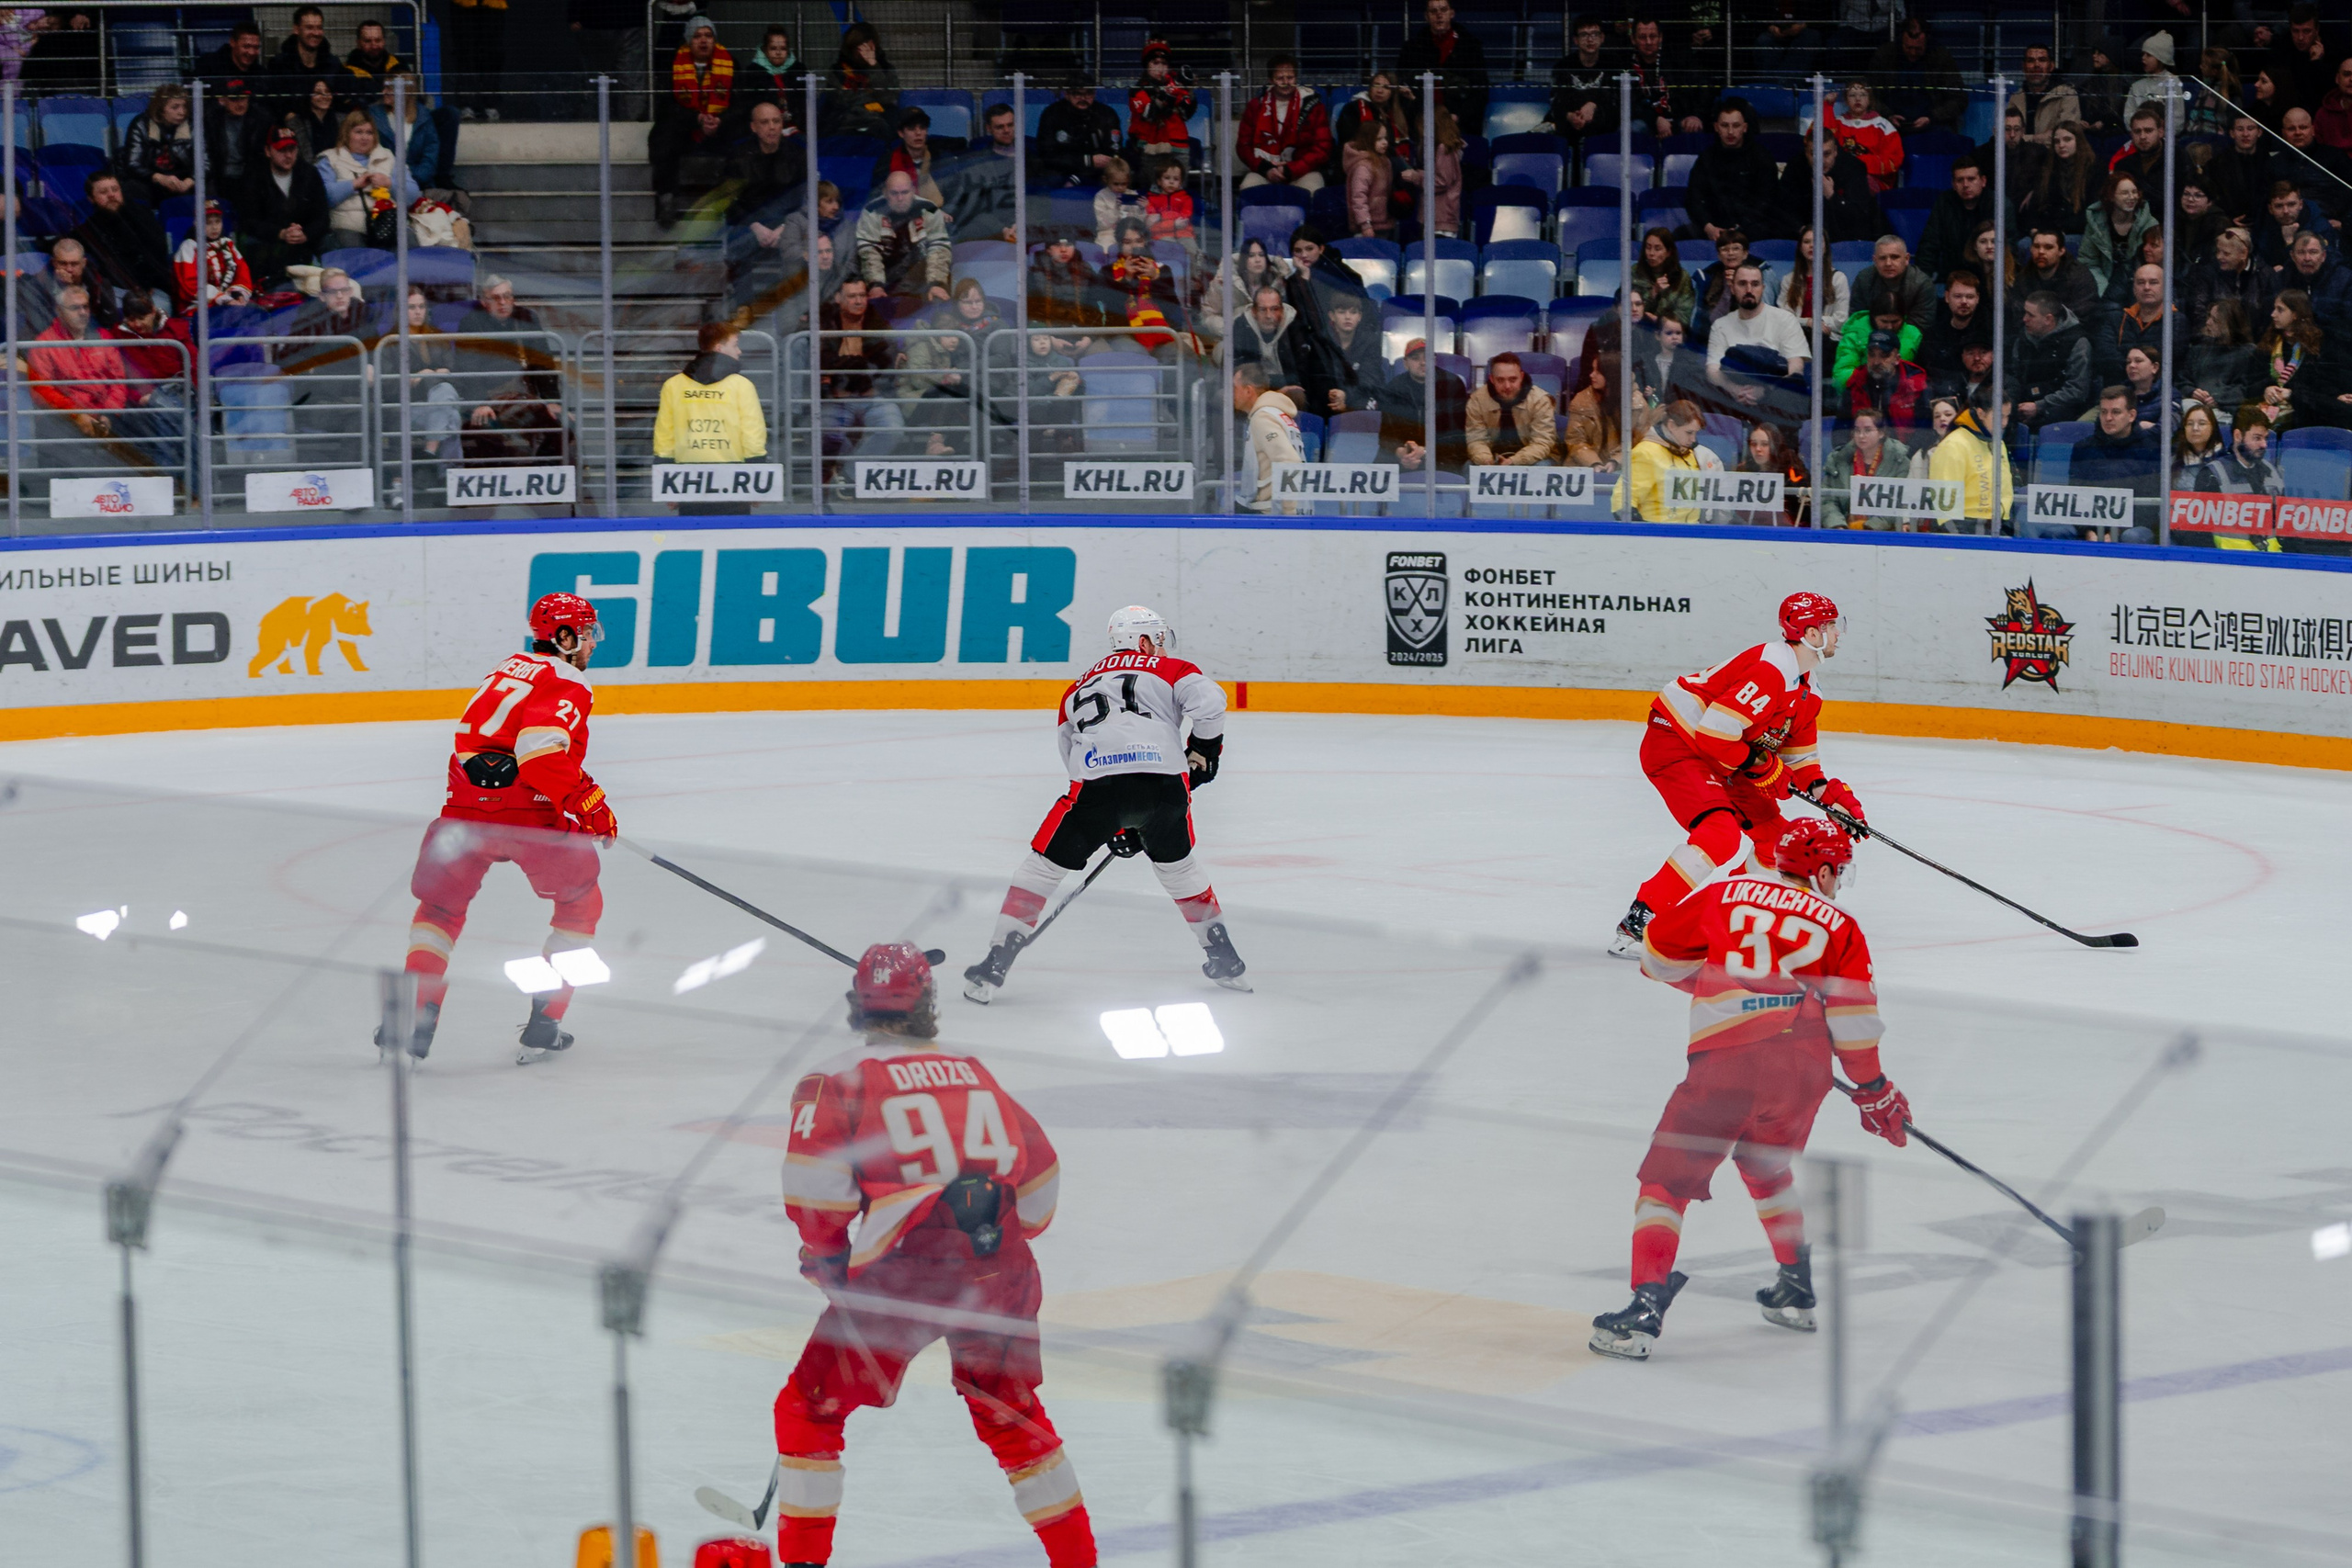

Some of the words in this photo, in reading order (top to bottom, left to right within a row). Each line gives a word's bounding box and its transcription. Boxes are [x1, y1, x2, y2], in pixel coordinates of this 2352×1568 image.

[684, 389, 726, 400] SAFETY
[690, 438, 731, 450] AFETY
[454, 472, 569, 500] KHL.RU
[662, 470, 775, 494] KHL.RU
[864, 468, 978, 491] KHL.RU
[1073, 468, 1185, 492] KHL.RU
[1280, 469, 1392, 495] KHL.RU
[1477, 471, 1587, 498] KHL.RU
[1671, 476, 1777, 504] KHL.RU
[93, 494, 120, 504] АВТО
[289, 487, 318, 498] АВТО
[297, 495, 333, 507] РАДИО
[1857, 482, 1958, 512] KHL.RU
[99, 502, 134, 513] РАДИО
[2034, 491, 2127, 520] KHL.RU
[2171, 498, 2272, 529] FONBET
[133, 560, 232, 585] ШИНЫ
[1389, 555, 1443, 569] FONBET
[1464, 568, 1556, 586] ФОНБЕТ
[523, 546, 1077, 669] SIBUR
[1464, 591, 1691, 614] КОНТИНЕНТАЛЬНАЯ
[1464, 613, 1606, 634] ХОККЕЙНАЯ
[1390, 650, 1444, 663] 2024/2025
[1464, 637, 1524, 654] ЛИГА
[2109, 652, 2165, 680] BEIJING
[2169, 656, 2223, 684] KUNLUN
[2229, 661, 2255, 688] RED
[2260, 663, 2295, 691] STAR
[1072, 673, 1152, 734] 51
[1735, 681, 1771, 716] 84
[555, 699, 582, 731] 27
[1098, 751, 1162, 766] ГАЗПРОМНЕФТЬ
[1721, 882, 1846, 932] LIKHACHYOV
[1724, 906, 1830, 979] 32
[874, 967, 891, 985] 94
[888, 1060, 980, 1091] DROZG
[880, 1089, 1019, 1185] 94
